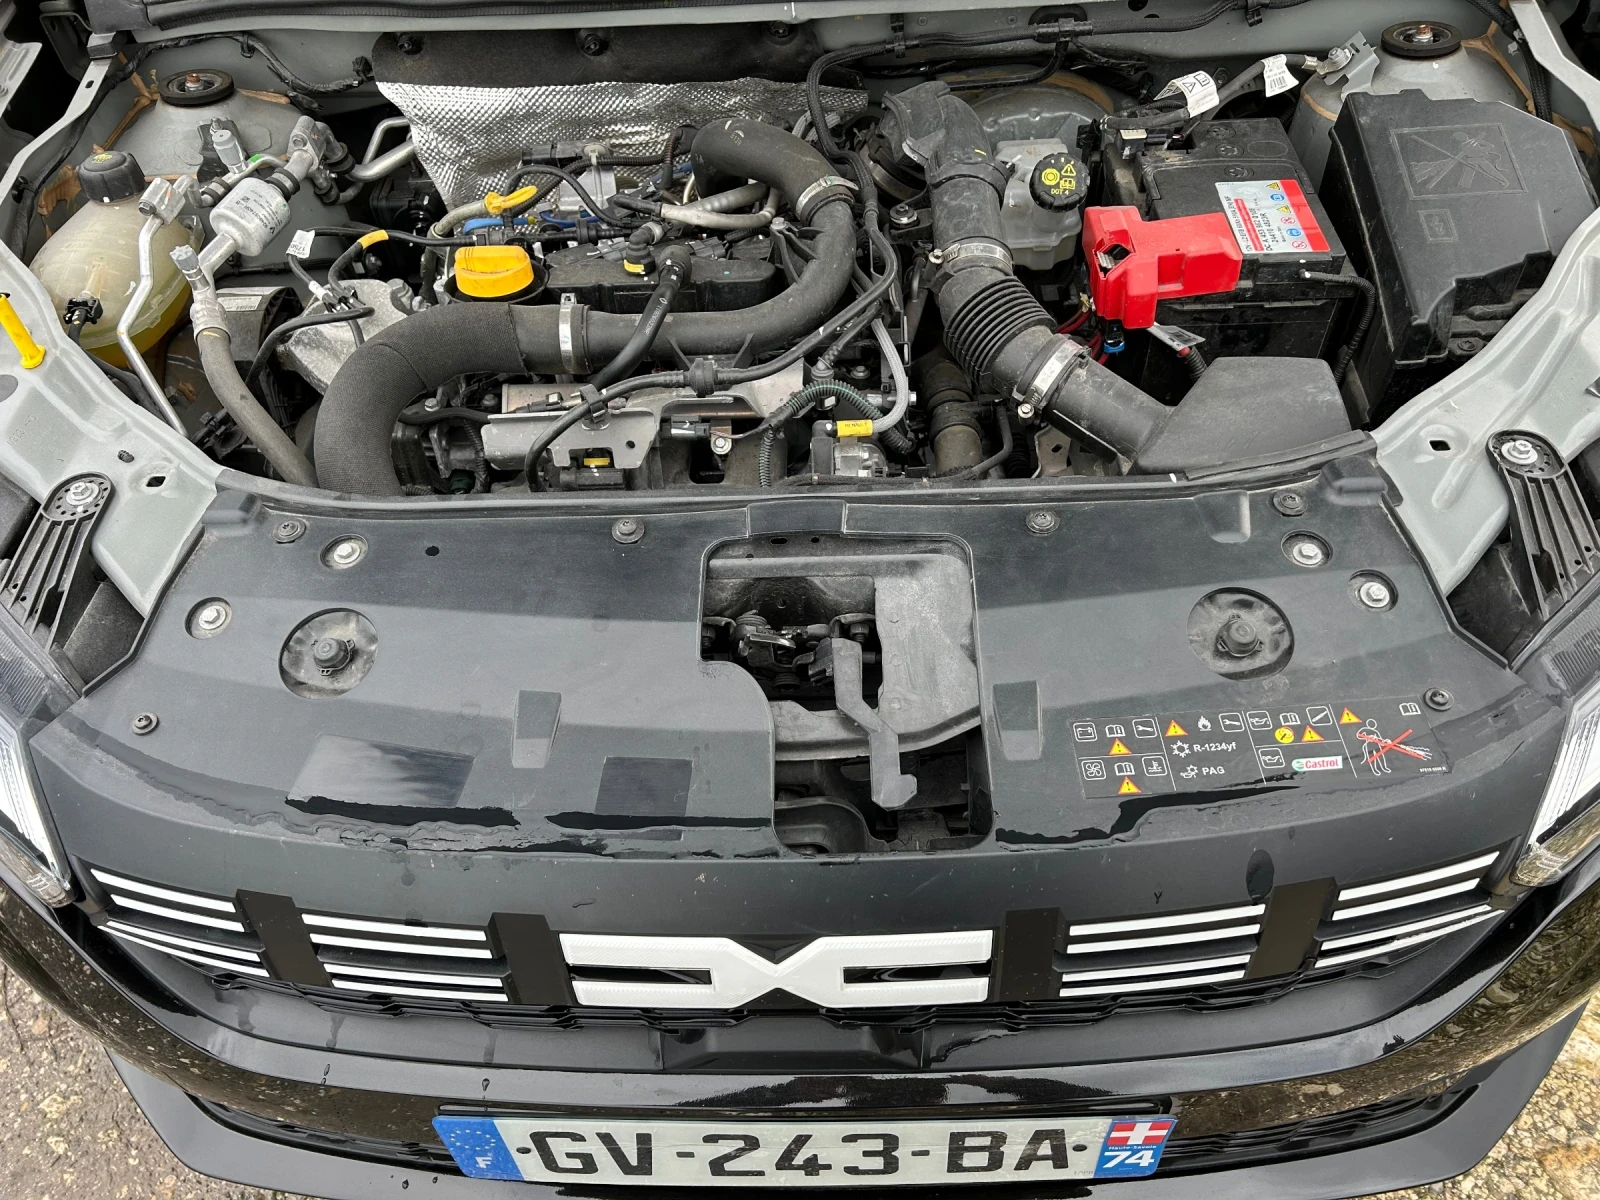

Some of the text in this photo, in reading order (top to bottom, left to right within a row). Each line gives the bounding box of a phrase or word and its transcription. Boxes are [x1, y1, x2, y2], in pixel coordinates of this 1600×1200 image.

[1192, 741, 1237, 753] R-1234yf
[1305, 758, 1340, 769] Castrol
[1201, 766, 1226, 775] PAG
[474, 1156, 493, 1169] F
[1103, 1150, 1155, 1168] 74
